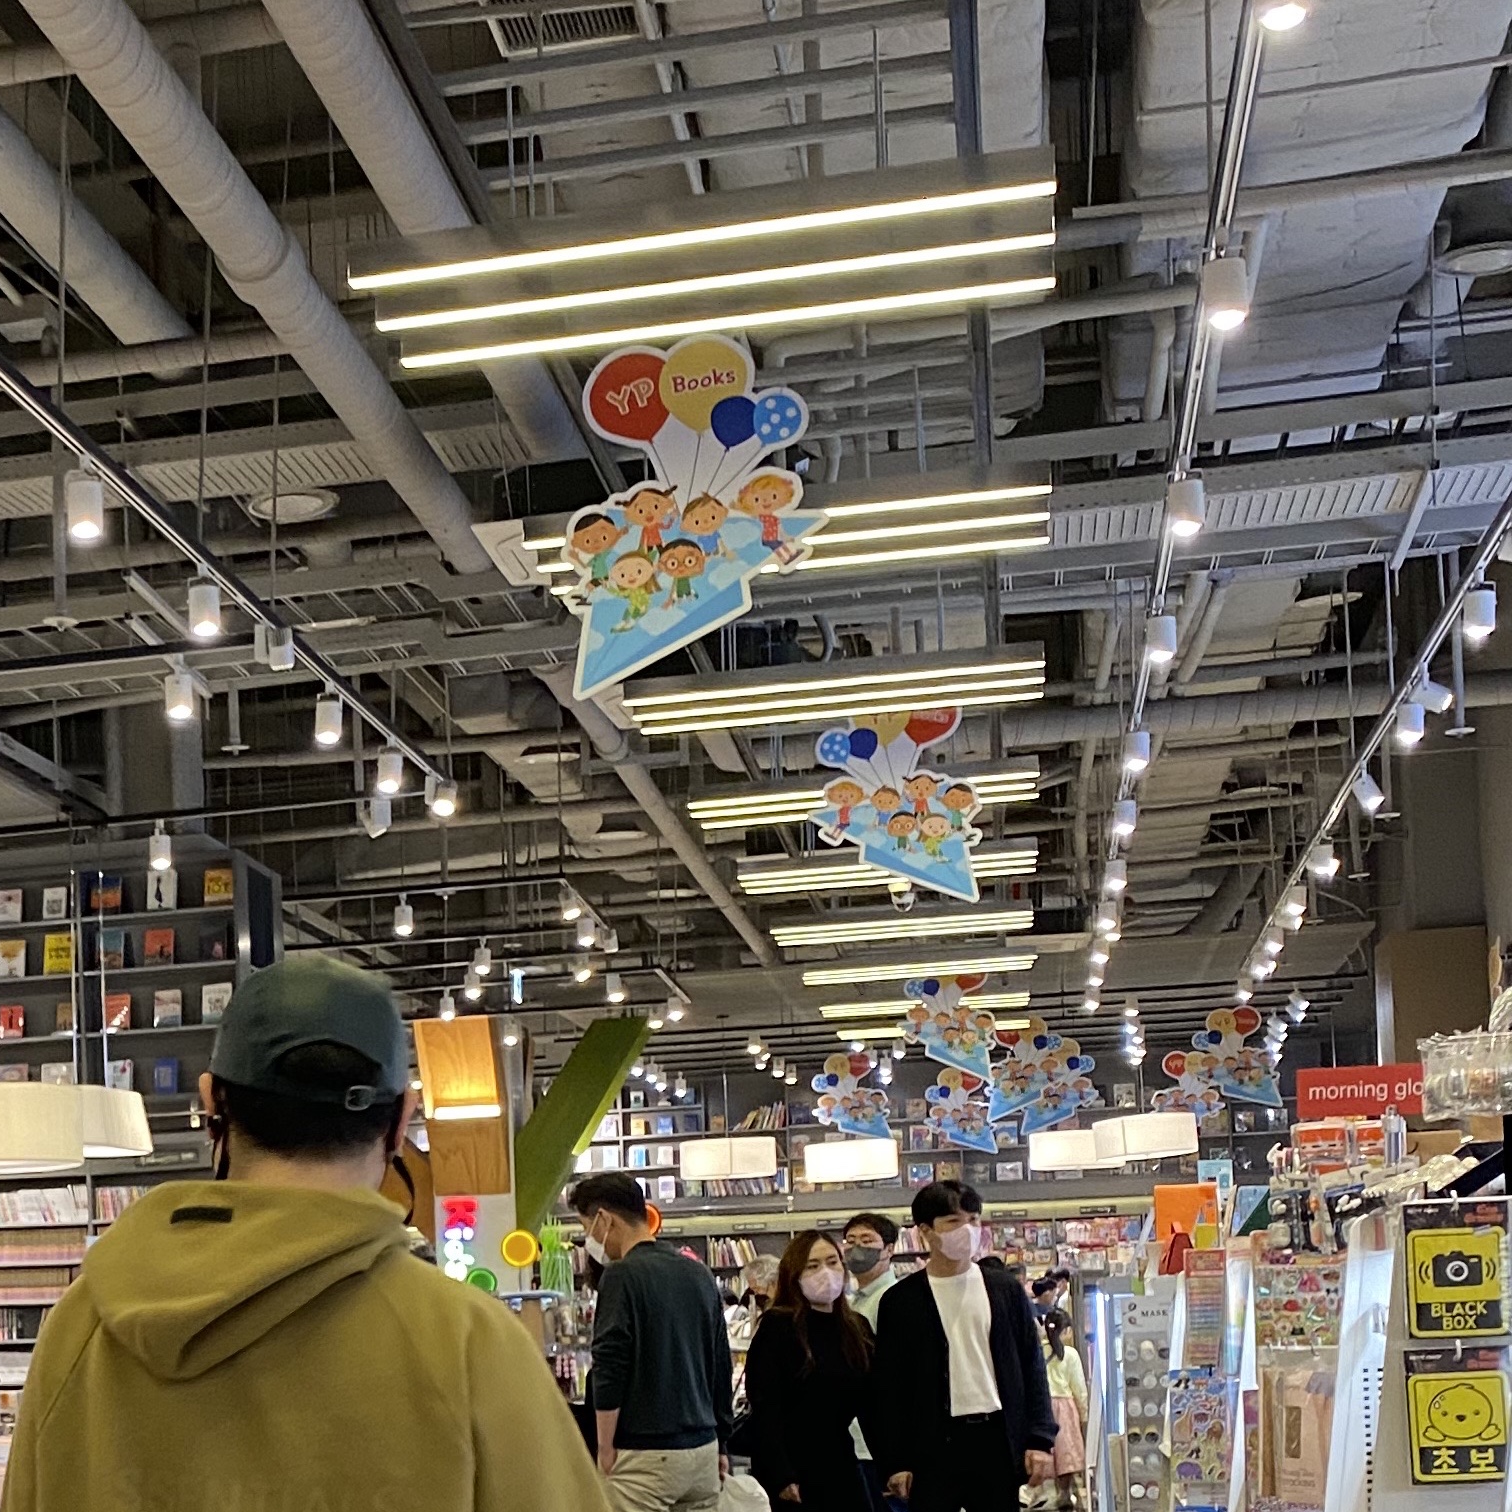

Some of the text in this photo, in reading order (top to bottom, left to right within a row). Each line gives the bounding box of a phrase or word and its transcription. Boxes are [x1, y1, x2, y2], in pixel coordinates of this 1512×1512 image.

[605, 368, 737, 416] YP Books
[1308, 1077, 1425, 1102] morning glo
[1430, 1300, 1488, 1318] BLACK
[1442, 1315, 1478, 1331] BOX
